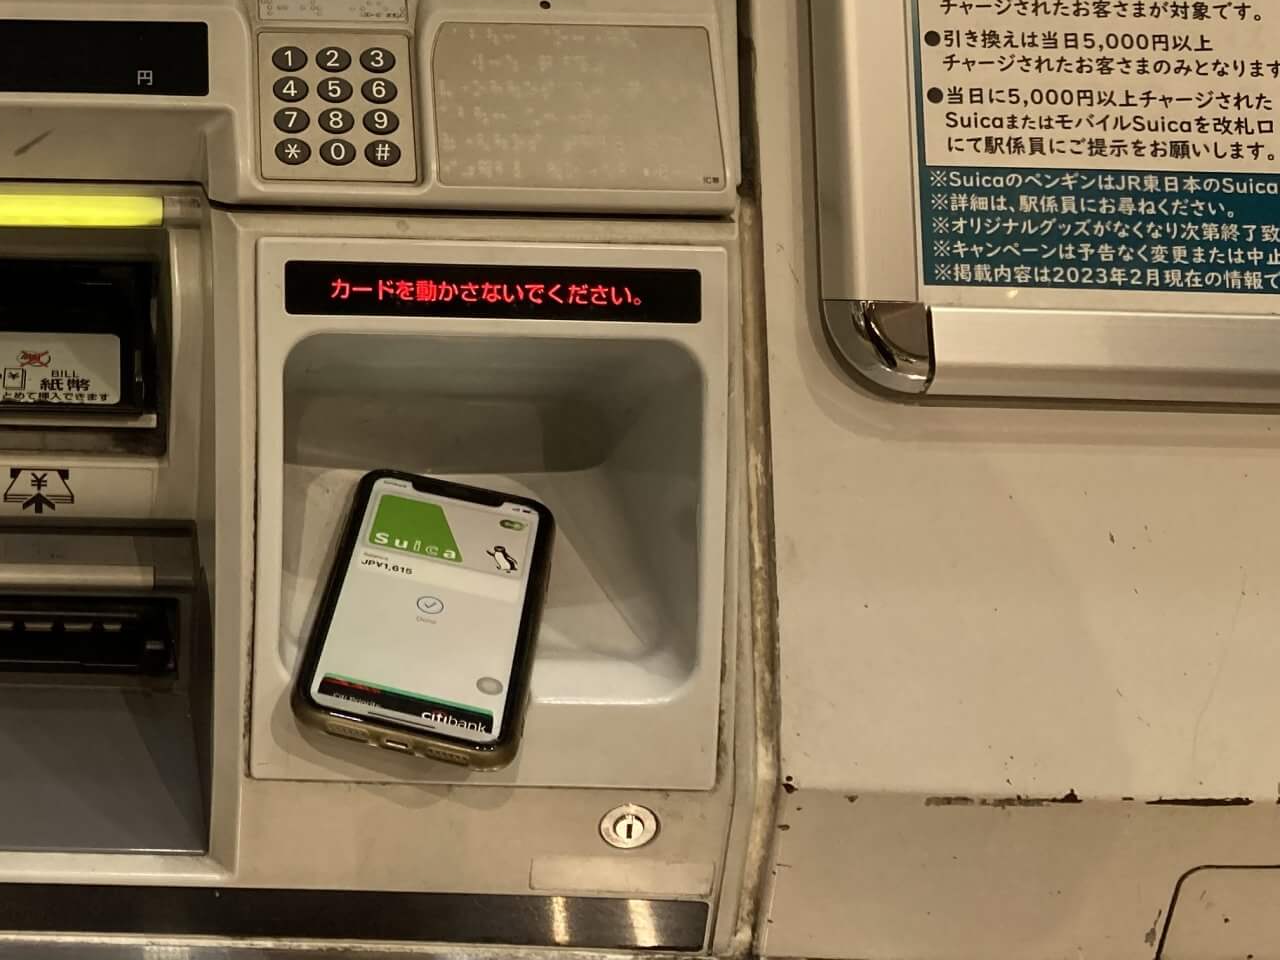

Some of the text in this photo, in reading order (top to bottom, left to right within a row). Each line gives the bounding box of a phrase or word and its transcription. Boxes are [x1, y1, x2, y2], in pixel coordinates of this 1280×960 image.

[284, 50, 294, 67] 1
[325, 50, 340, 67] 2
[369, 50, 385, 67] 3
[137, 70, 153, 86] 円
[282, 80, 298, 97] 4
[327, 81, 342, 98] 5
[371, 81, 386, 98] 6
[285, 112, 298, 128] 7
[329, 111, 344, 129] 8
[373, 112, 388, 129] 9
[946, 111, 1274, 135] SuicaまたはモバイルSuicaを改札口
[330, 143, 346, 161] 0
[948, 136, 1275, 161] にて駅係員にご提示をお願いします。
[330, 278, 642, 307] カードを動かさないでください。
[51, 370, 79, 378] BILL
[373, 531, 457, 560] Suica
[421, 711, 487, 733] citibank
